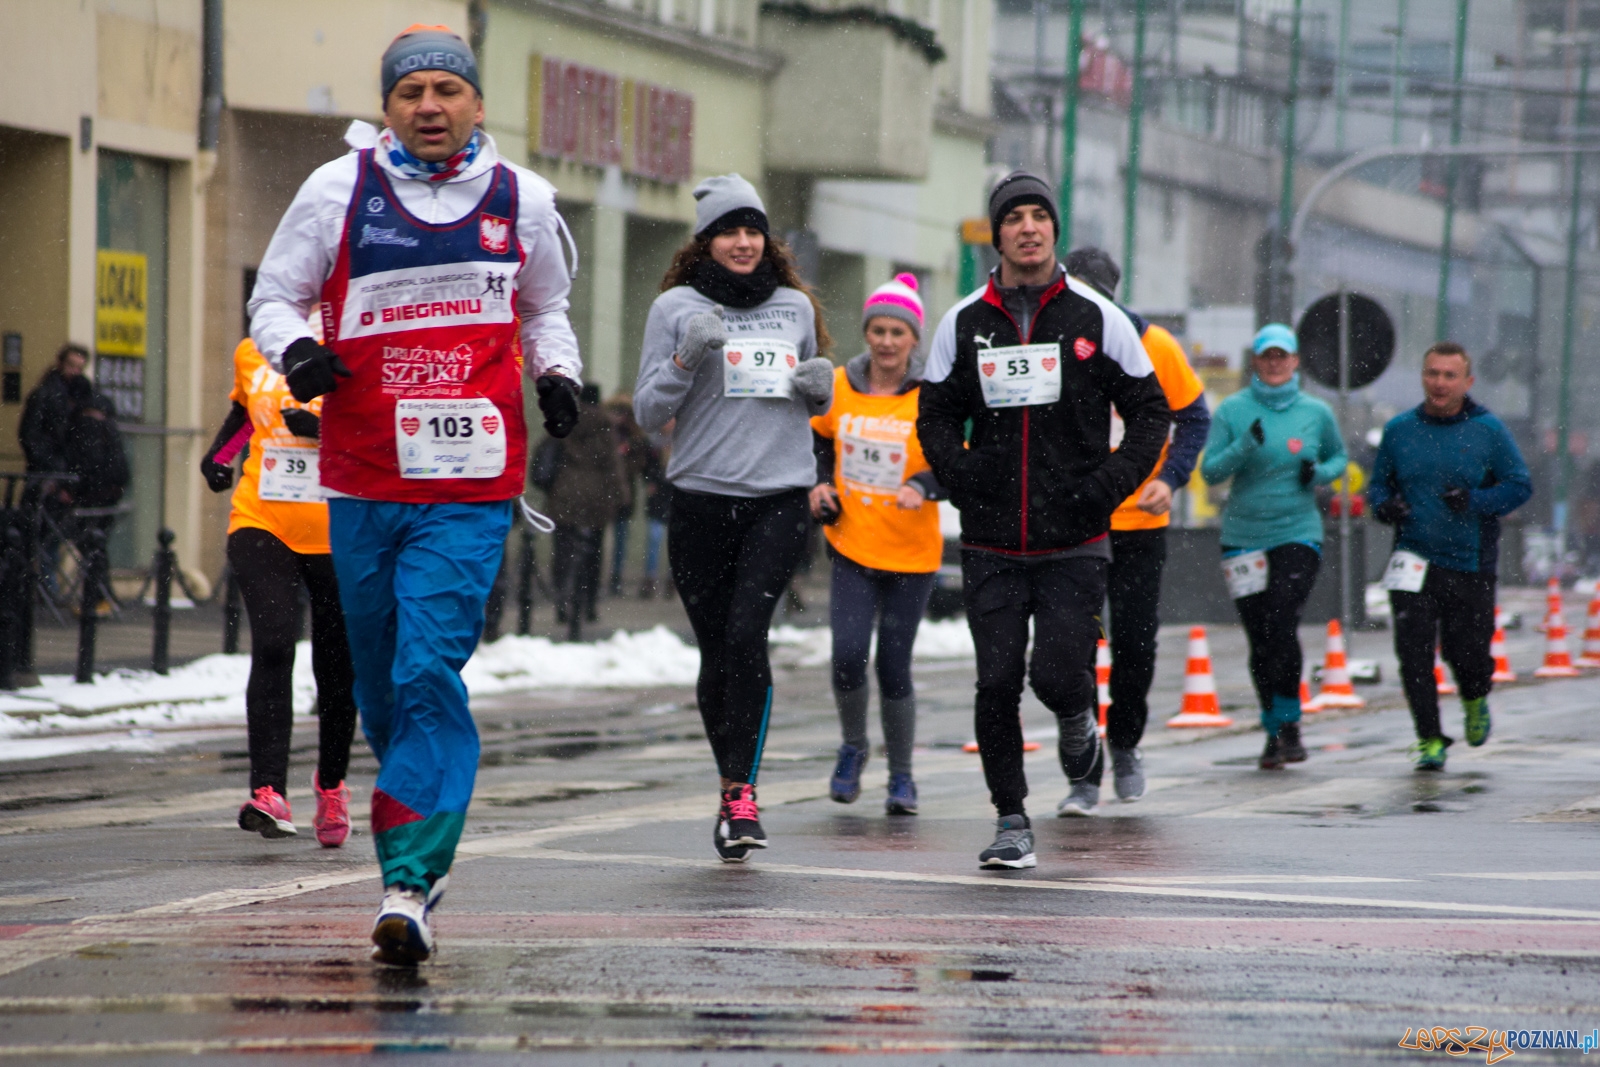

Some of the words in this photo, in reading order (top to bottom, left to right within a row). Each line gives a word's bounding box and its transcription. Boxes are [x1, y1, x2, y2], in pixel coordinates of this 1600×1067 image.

[386, 278, 418, 290] PORTAL
[420, 276, 436, 285] DLA
[437, 271, 480, 283] BIEGACZY
[360, 310, 375, 326] O
[738, 323, 755, 332] ME
[758, 321, 784, 331] SICK
[382, 345, 458, 364] DRUŻYNA
[753, 351, 776, 367] 97
[381, 362, 473, 384] SZPIKU
[1007, 359, 1030, 376] 53
[427, 416, 474, 438] 103
[862, 447, 881, 463] 16
[285, 458, 307, 474] 39
